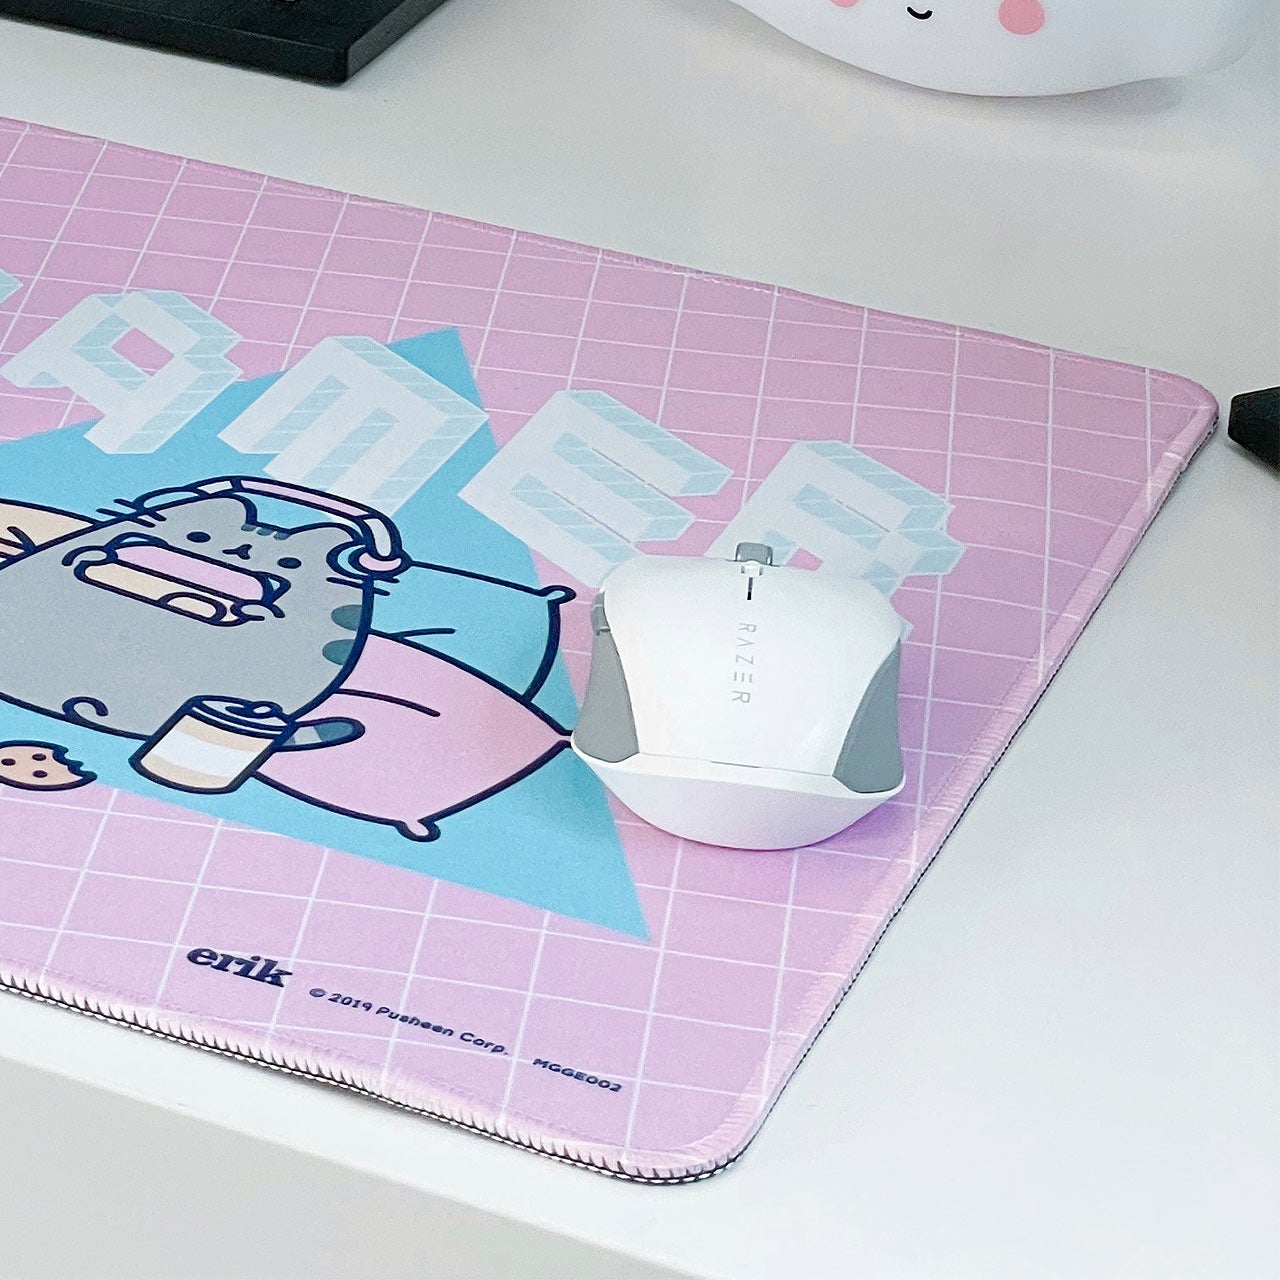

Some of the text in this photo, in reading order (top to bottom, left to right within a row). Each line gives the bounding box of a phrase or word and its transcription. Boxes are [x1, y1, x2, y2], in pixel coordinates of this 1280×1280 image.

[731, 622, 757, 704] RAZER
[186, 947, 294, 988] erik
[327, 992, 373, 1012] 2019
[375, 1005, 455, 1037] Pusheen
[459, 1031, 510, 1056] Corp.
[531, 1057, 623, 1093] MGGE002
